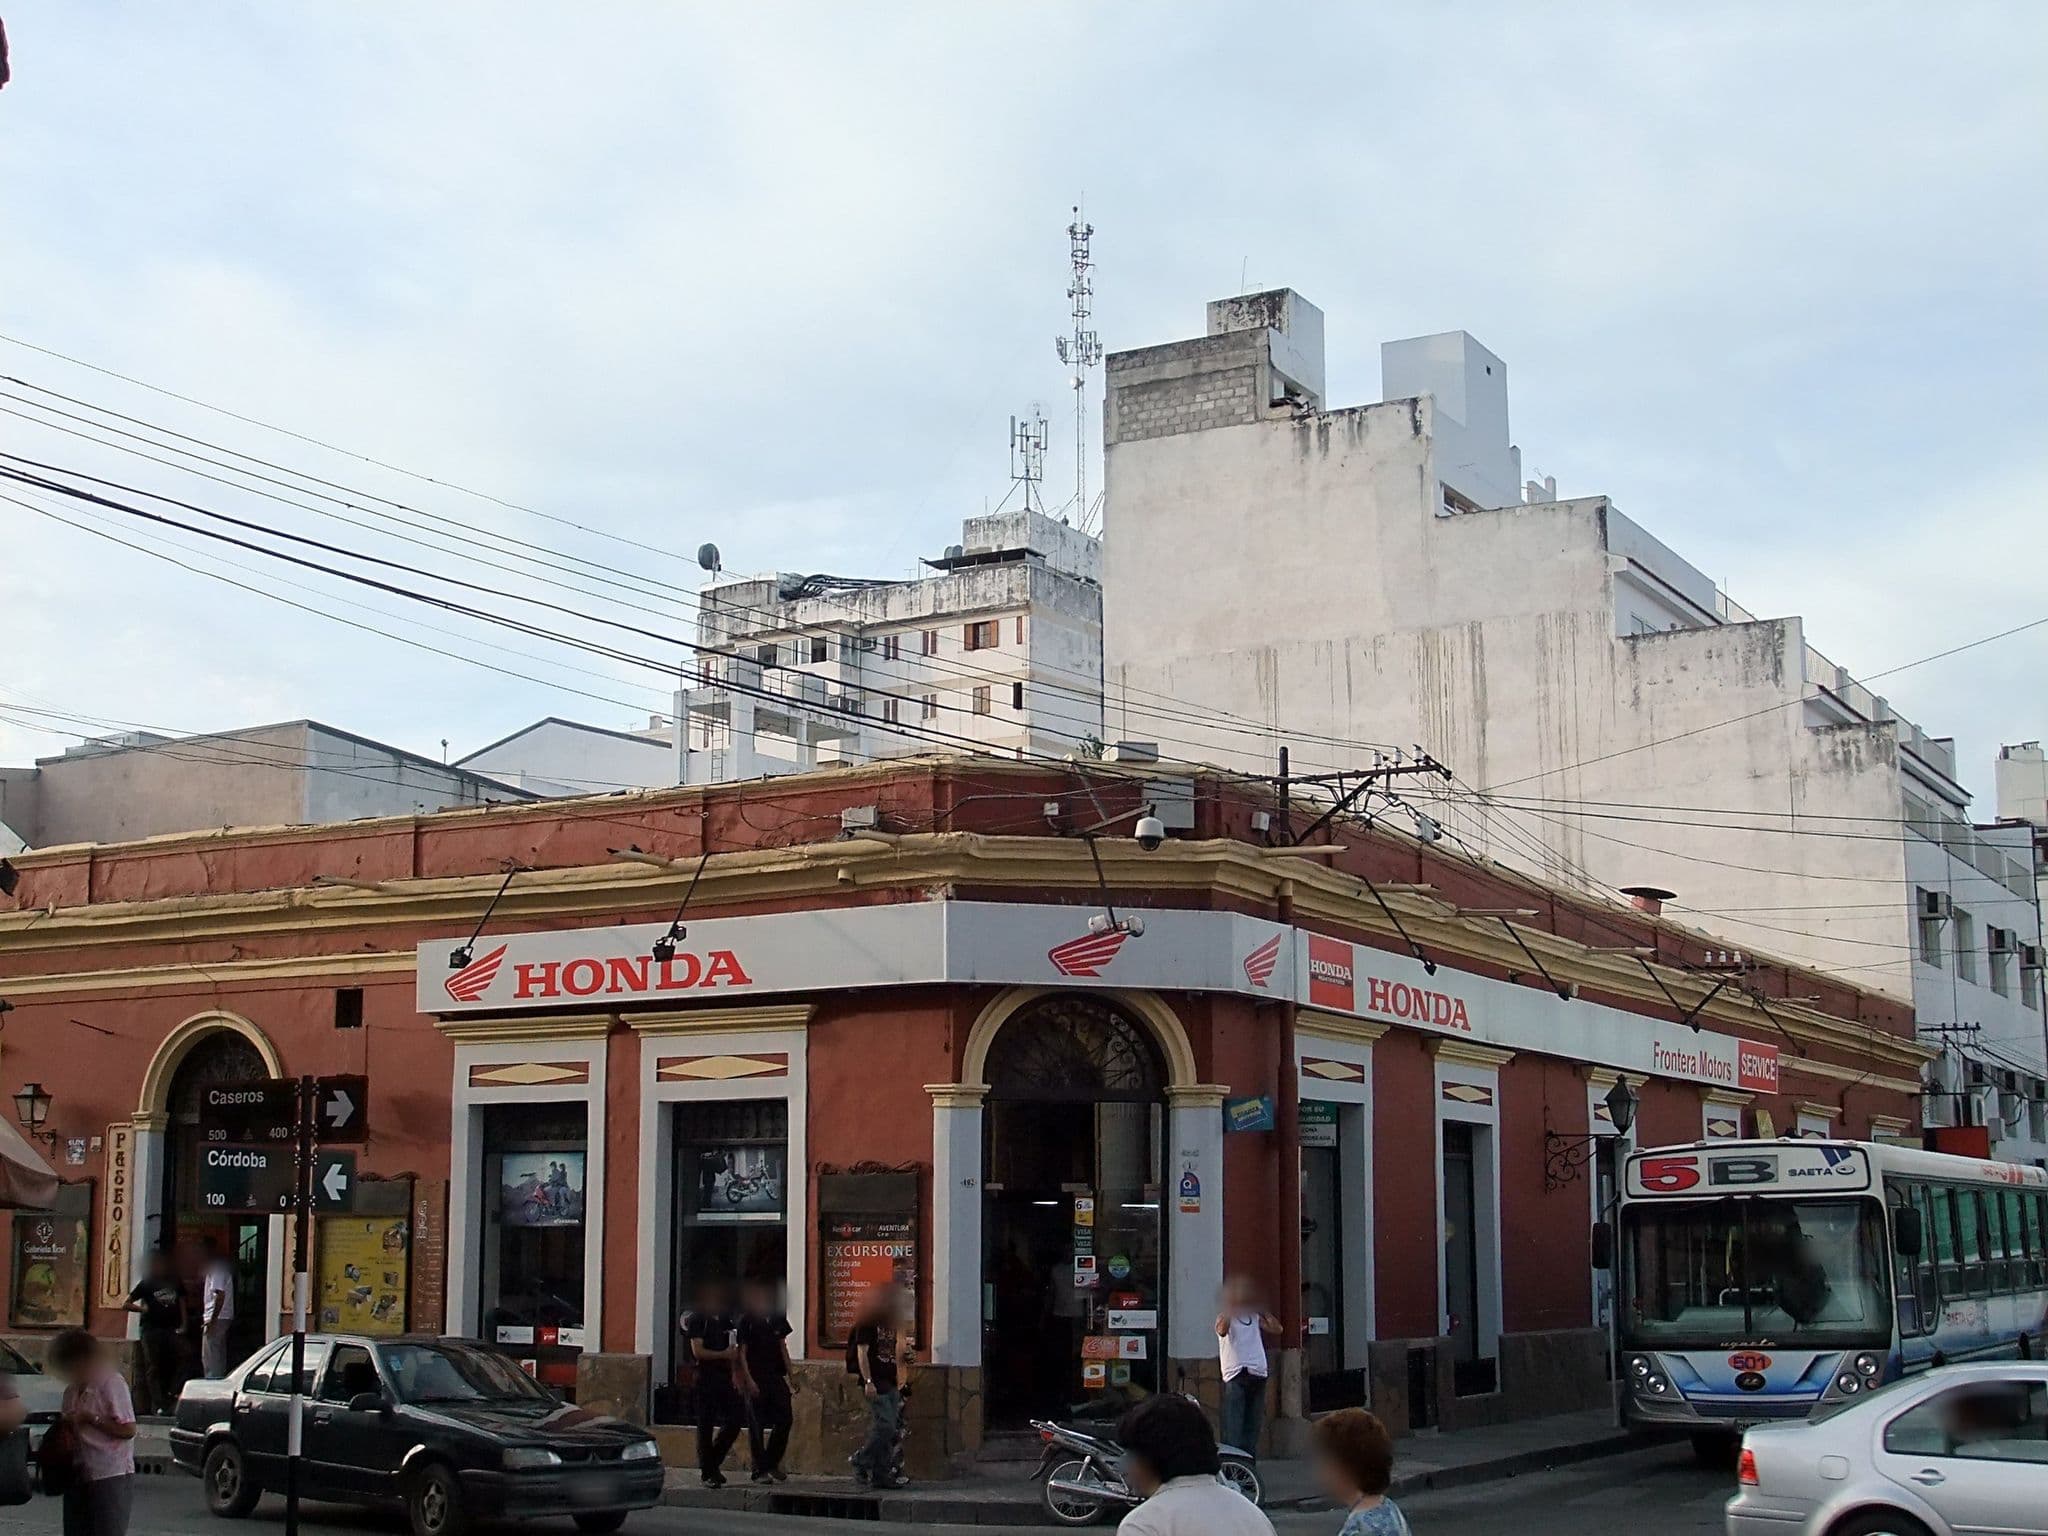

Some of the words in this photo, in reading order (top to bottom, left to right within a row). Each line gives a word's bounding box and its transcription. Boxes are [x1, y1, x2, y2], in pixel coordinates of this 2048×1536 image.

[513, 949, 753, 999] HONDA
[1310, 959, 1353, 981] HONDA
[1367, 976, 1472, 1032] HONDA
[1653, 1040, 1696, 1074] Frontera
[1699, 1050, 1732, 1082] Motors
[1741, 1053, 1776, 1081] SERVICE
[209, 1090, 264, 1105] Caseros
[208, 1129, 227, 1141] 500
[269, 1127, 288, 1139] 400
[207, 1150, 267, 1168] Córdoba
[1640, 1156, 1700, 1192] 5
[1713, 1160, 1775, 1185] B
[1788, 1167, 1833, 1177] SAETA
[206, 1193, 226, 1206] 100
[279, 1195, 287, 1208] 0
[878, 1224, 910, 1232] AVENTURA
